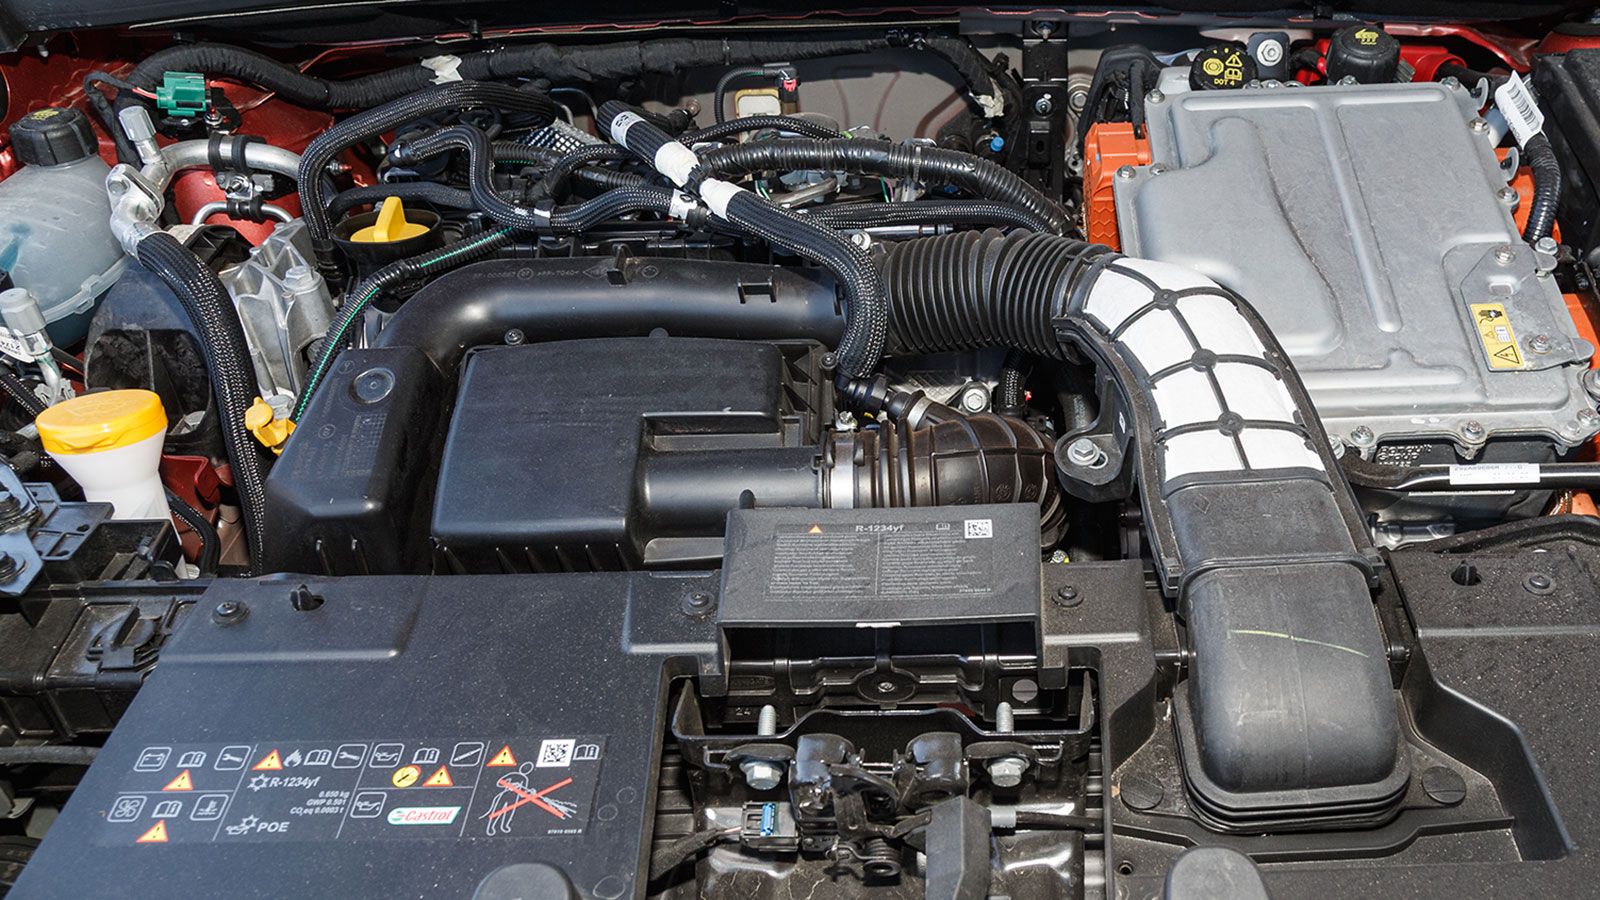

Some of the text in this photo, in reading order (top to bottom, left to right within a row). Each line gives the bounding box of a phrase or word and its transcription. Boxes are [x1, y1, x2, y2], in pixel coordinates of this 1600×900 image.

[855, 524, 904, 533] R-1234yf
[269, 776, 320, 789] R-1234yf
[404, 809, 453, 821] Castrol
[256, 822, 290, 832] POE
